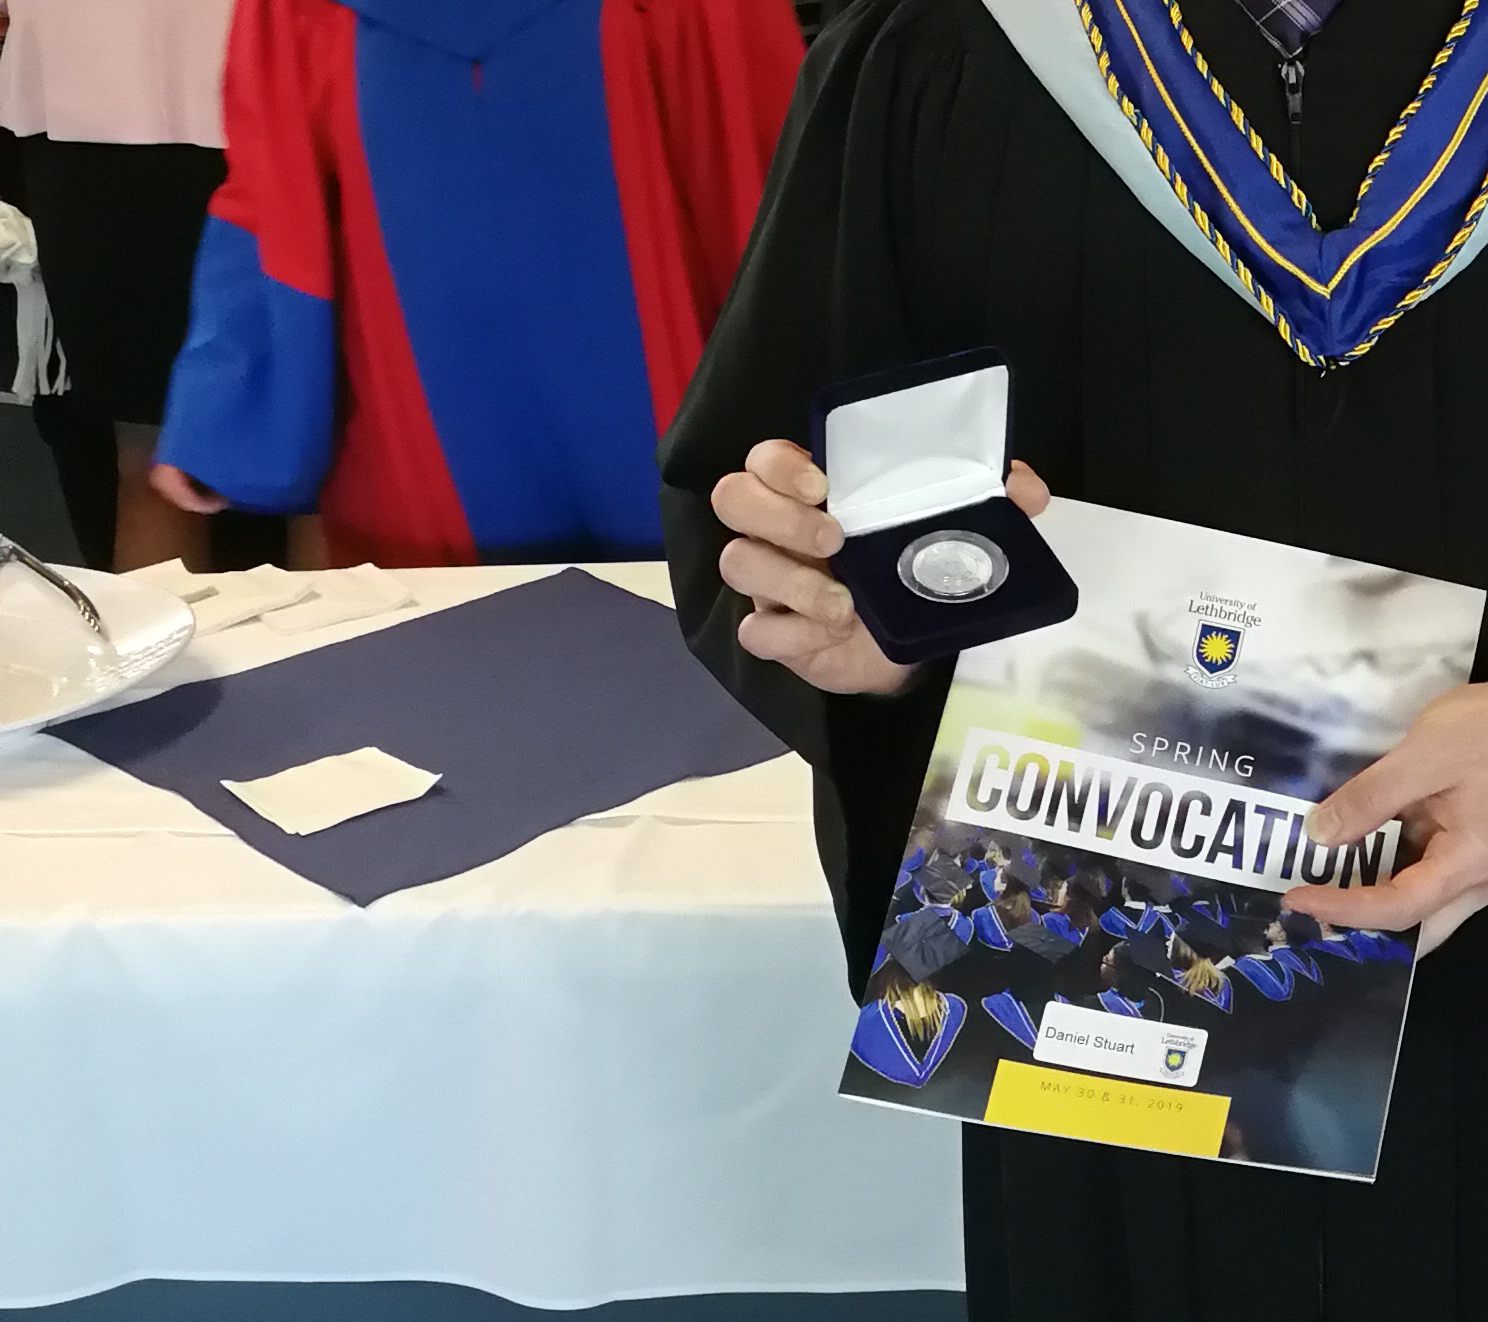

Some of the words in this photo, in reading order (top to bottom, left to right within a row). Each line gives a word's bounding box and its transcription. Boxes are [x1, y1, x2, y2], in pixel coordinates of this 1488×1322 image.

[1188, 599, 1262, 628] Lethbridge
[1199, 590, 1246, 610] University
[1246, 602, 1257, 611] of
[1129, 732, 1255, 778] SPRING
[1044, 1026, 1090, 1046] Daniel
[1093, 1036, 1135, 1055] Stuart
[1040, 1081, 1071, 1093] MAY
[1078, 1088, 1095, 1099] 30
[1101, 1091, 1110, 1102] &
[1147, 1098, 1183, 1113] 2019
